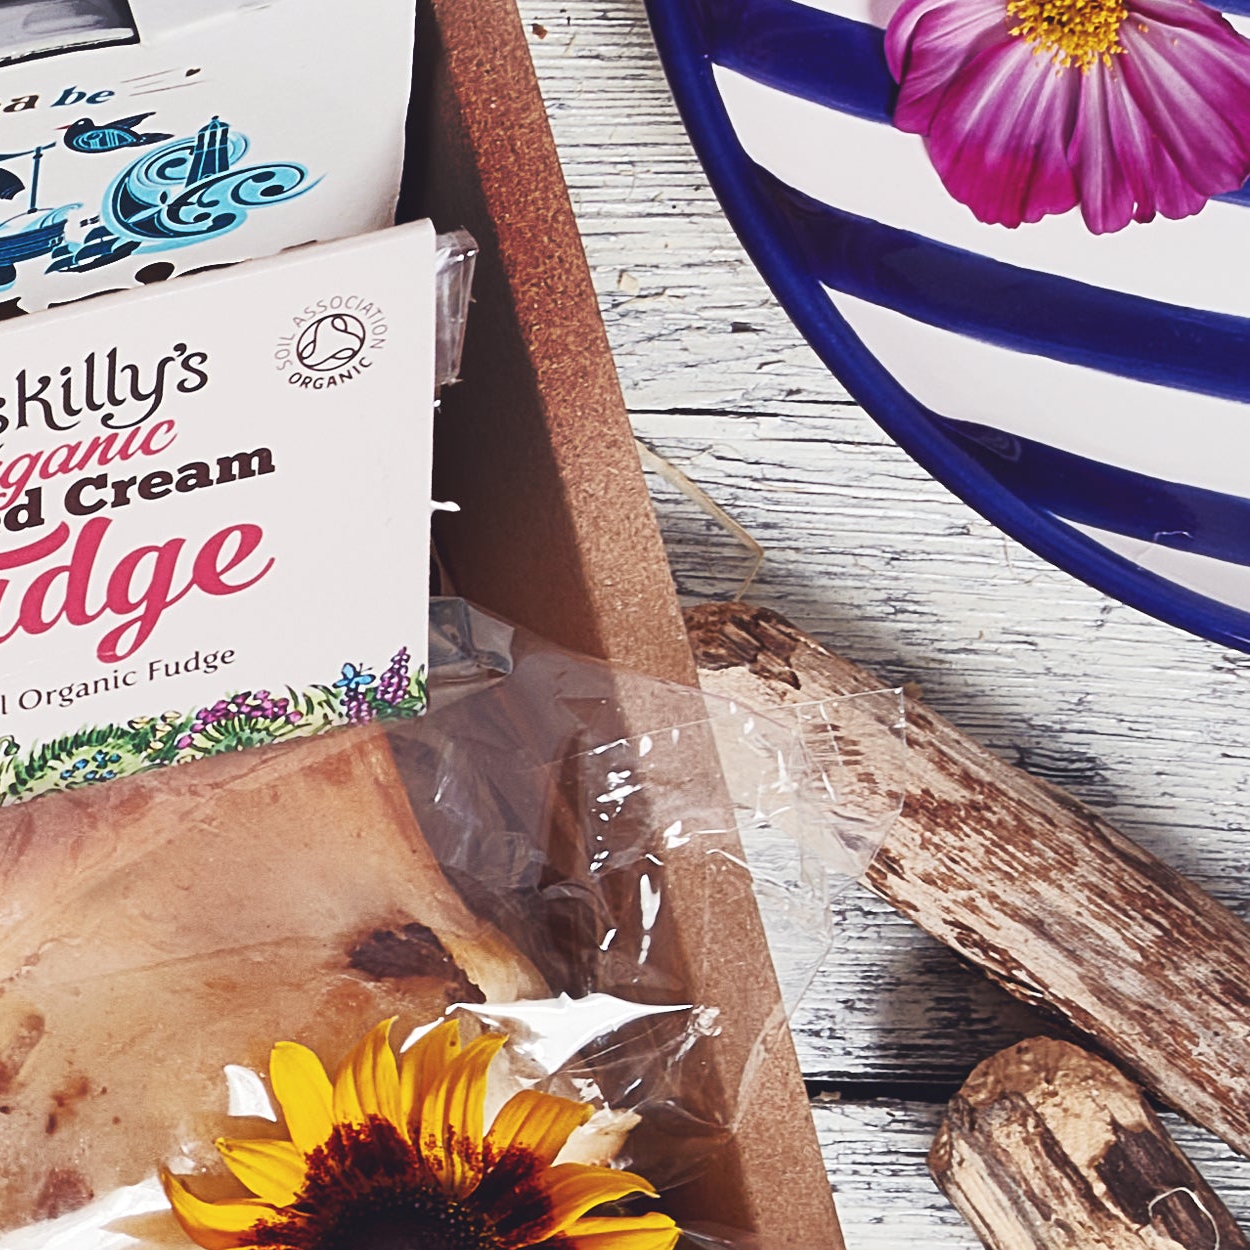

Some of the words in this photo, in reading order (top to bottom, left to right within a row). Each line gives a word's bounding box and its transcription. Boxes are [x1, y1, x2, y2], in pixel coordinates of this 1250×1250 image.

[50, 86, 115, 107] be
[275, 334, 296, 371] SOIL
[292, 295, 388, 350] ASSOCIATION
[288, 356, 373, 390] ORGANIC
[64, 447, 276, 515] Cream
[18, 669, 138, 708] Organic
[149, 647, 236, 682] Fudge
